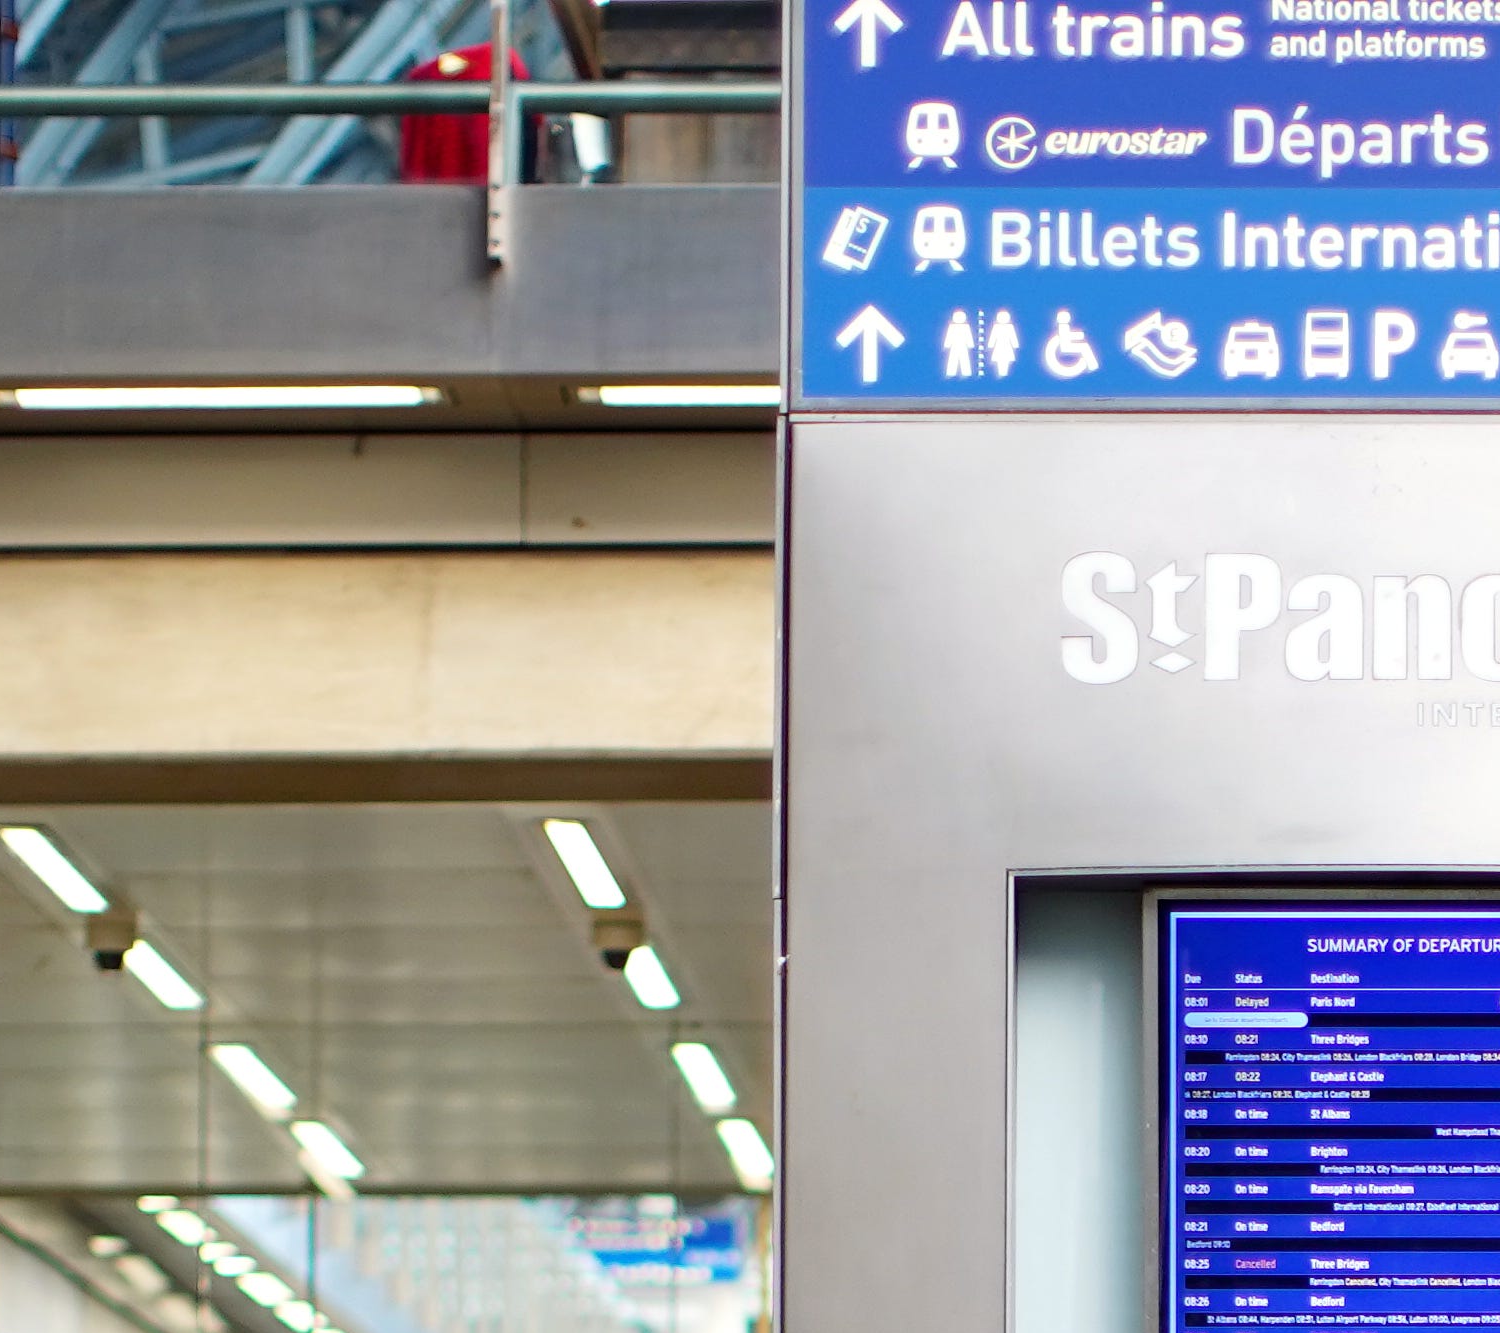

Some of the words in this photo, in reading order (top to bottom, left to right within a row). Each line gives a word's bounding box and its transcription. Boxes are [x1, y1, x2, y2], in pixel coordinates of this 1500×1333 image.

[1269, 0, 1402, 23] National
[941, 0, 1035, 58] All
[1051, 1, 1246, 59] trains
[1268, 29, 1328, 59] and
[1334, 29, 1488, 64] platforms
[1043, 126, 1209, 157] eurostar
[1232, 105, 1491, 179] Départs
[989, 210, 1202, 269] Billets
[1307, 938, 1389, 953] SUMMARY
[1392, 938, 1415, 953] OF
[1184, 973, 1202, 984] Due
[1235, 973, 1263, 984] Status
[1310, 972, 1360, 984] Destination
[1235, 996, 1270, 1010] Delayed
[1310, 996, 1333, 1008] Paris
[1333, 996, 1356, 1008] Nord
[1310, 1034, 1336, 1045] Three
[1336, 1034, 1370, 1047] Bridges
[1234, 1071, 1261, 1082] 08:22
[1310, 1071, 1349, 1084] Elephant
[1348, 1071, 1357, 1082] &
[1356, 1071, 1385, 1082] Castle
[1234, 1108, 1248, 1120] On
[1247, 1108, 1269, 1120] time
[1310, 1108, 1321, 1120] St
[1321, 1108, 1351, 1120] Albans
[1184, 1146, 1211, 1157] 08:20
[1234, 1146, 1248, 1157] On
[1247, 1146, 1269, 1157] time
[1310, 1146, 1349, 1159] Brighton
[1184, 1183, 1211, 1195] 08:20
[1234, 1183, 1248, 1195] On
[1247, 1183, 1269, 1195] time
[1310, 1183, 1353, 1197] Ramsgate
[1367, 1183, 1415, 1195] Faversham
[1234, 1221, 1248, 1232] On
[1247, 1221, 1269, 1232] time
[1309, 1221, 1345, 1232] Bedford
[1235, 1258, 1277, 1270] Cancelled
[1309, 1258, 1336, 1270] Three
[1336, 1258, 1370, 1272] Bridges
[1234, 1296, 1248, 1307] On
[1247, 1296, 1269, 1307] time
[1309, 1296, 1346, 1307] Bedford
